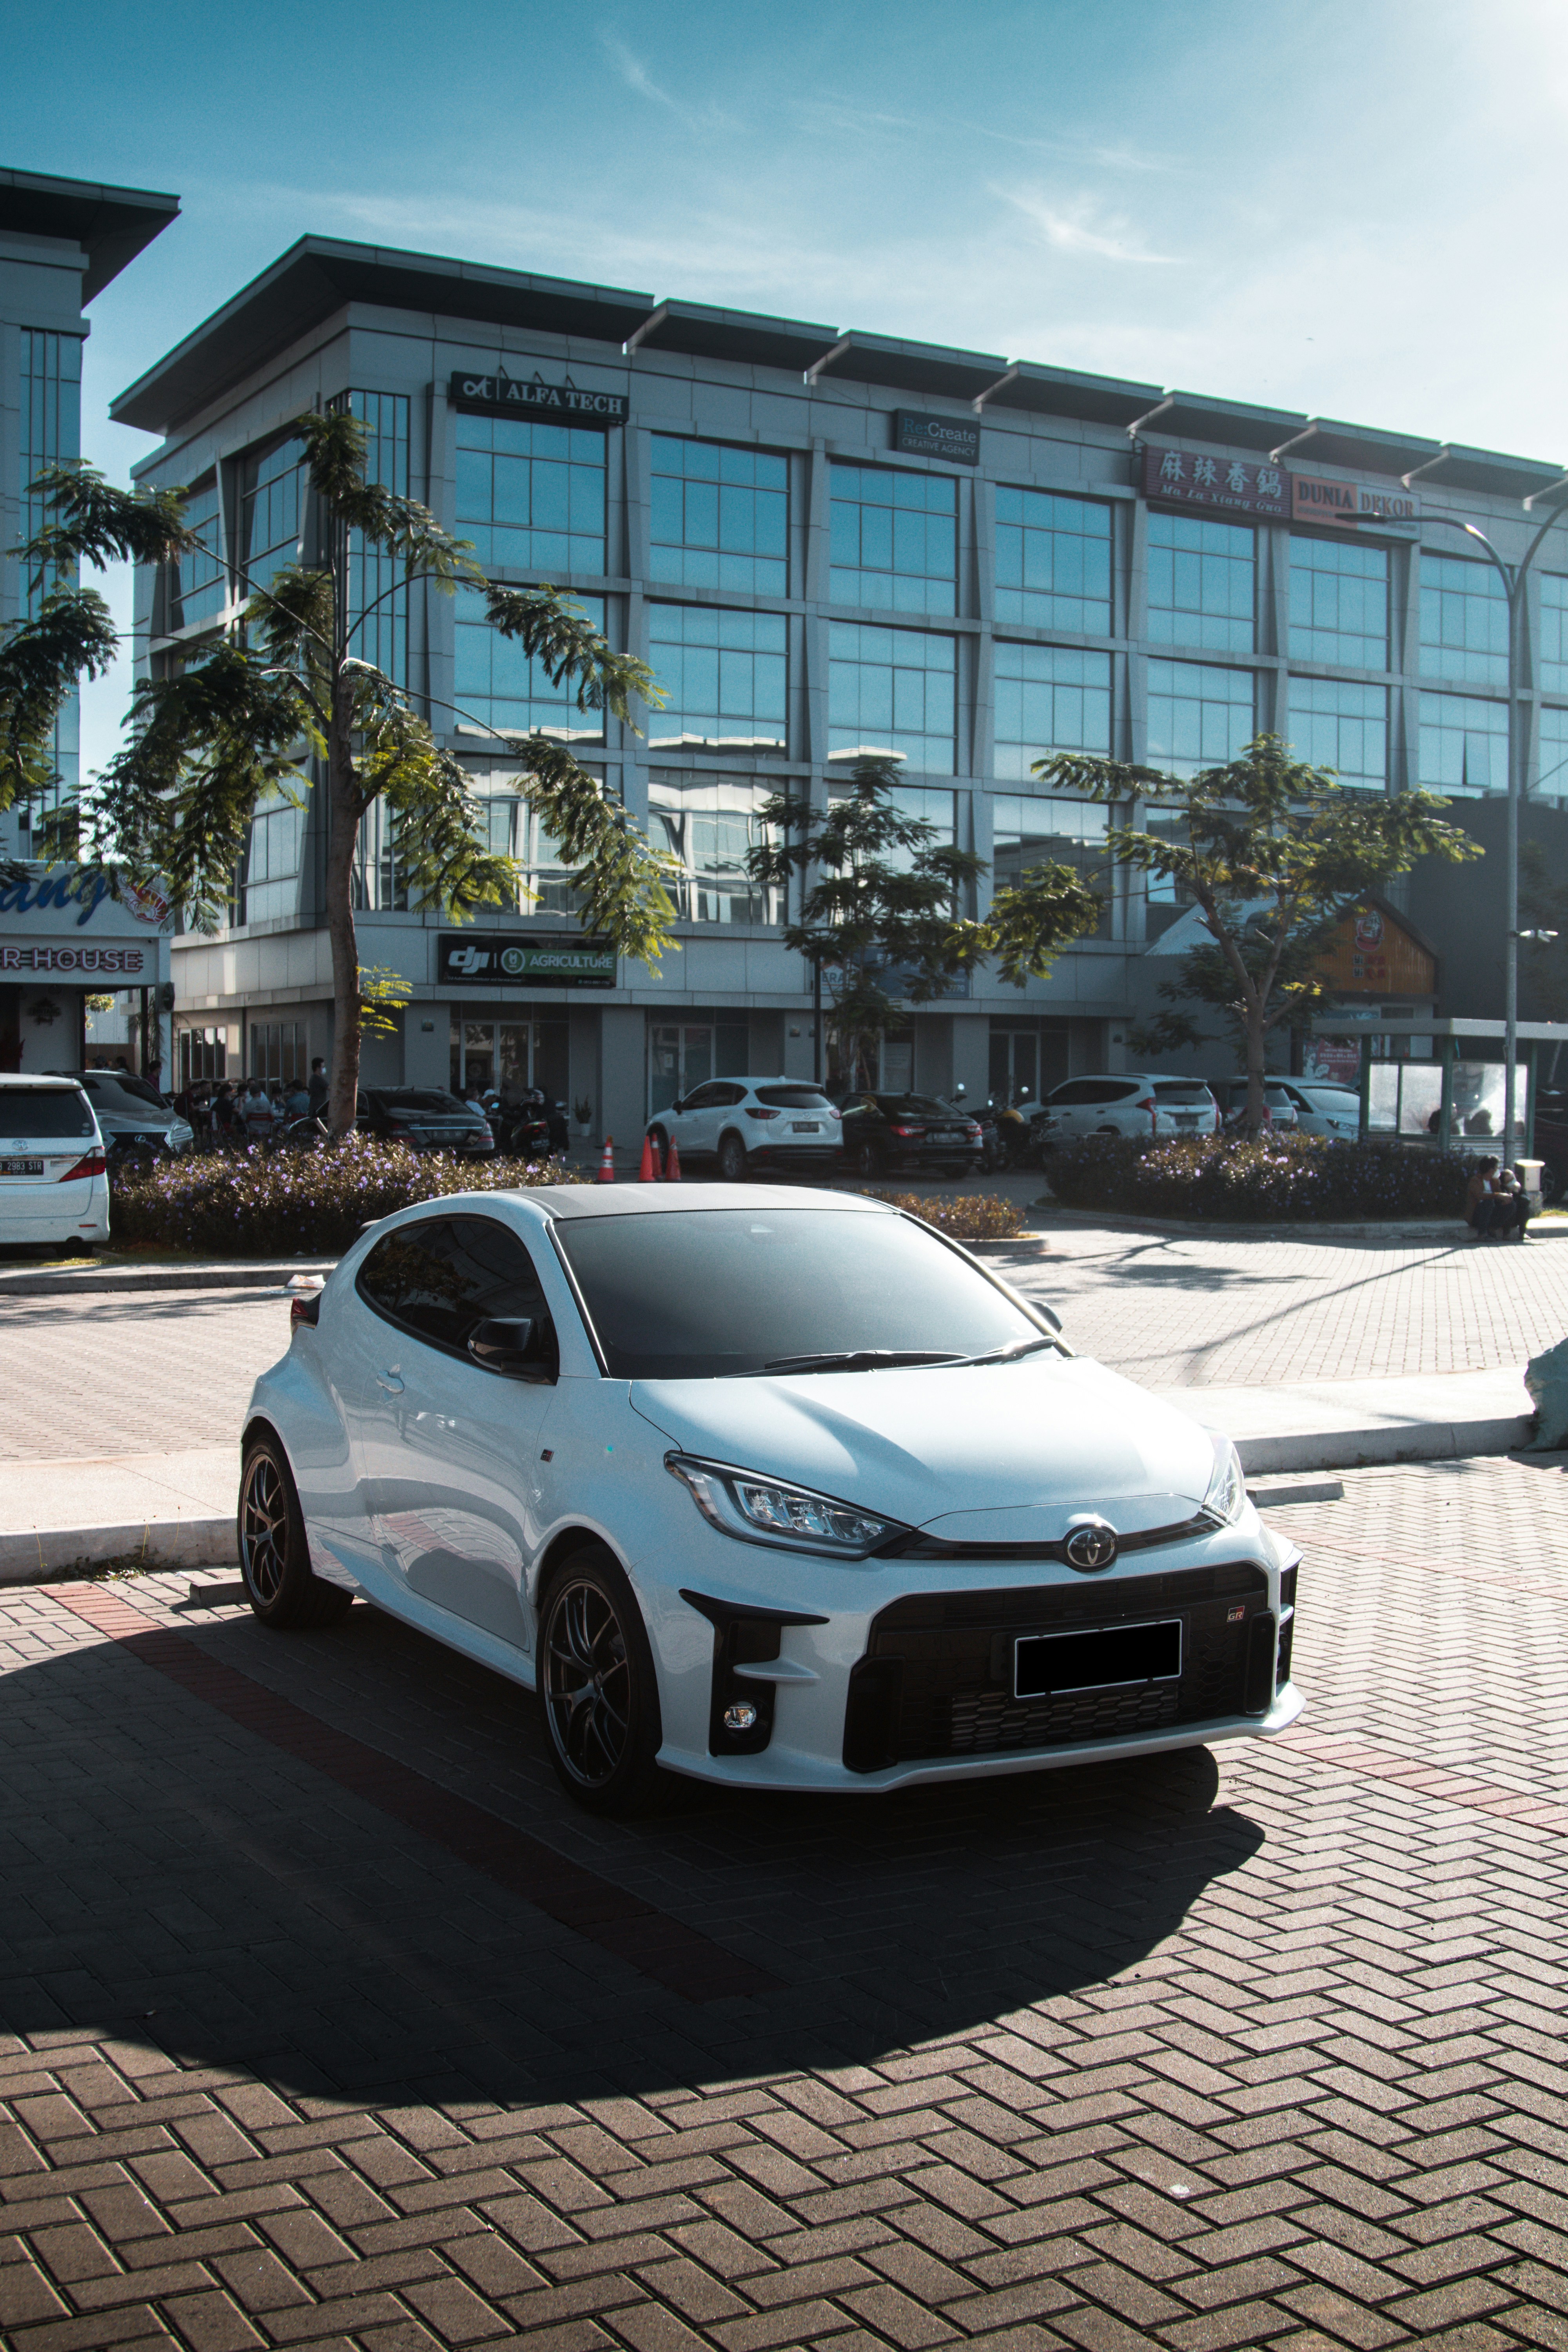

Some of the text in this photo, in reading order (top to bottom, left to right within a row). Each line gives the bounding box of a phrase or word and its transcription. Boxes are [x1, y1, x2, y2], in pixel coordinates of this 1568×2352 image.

[506, 383, 622, 415] ALFA TECH
[903, 418, 976, 443] Re:Create
[902, 437, 976, 456] CREATIVE AGENCY
[1159, 450, 1282, 498] 麻辣香鍋
[1160, 485, 1282, 512] Ma La Xiang Guo
[1298, 481, 1354, 508] DUNIA
[1361, 493, 1414, 516] DEKOR
[2, 947, 141, 973] R HOUSE
[529, 955, 613, 968] AGRICULTURE
[7, 1161, 25, 1170] 2983
[29, 1161, 42, 1170] STR
[1229, 1612, 1243, 1620] GR
